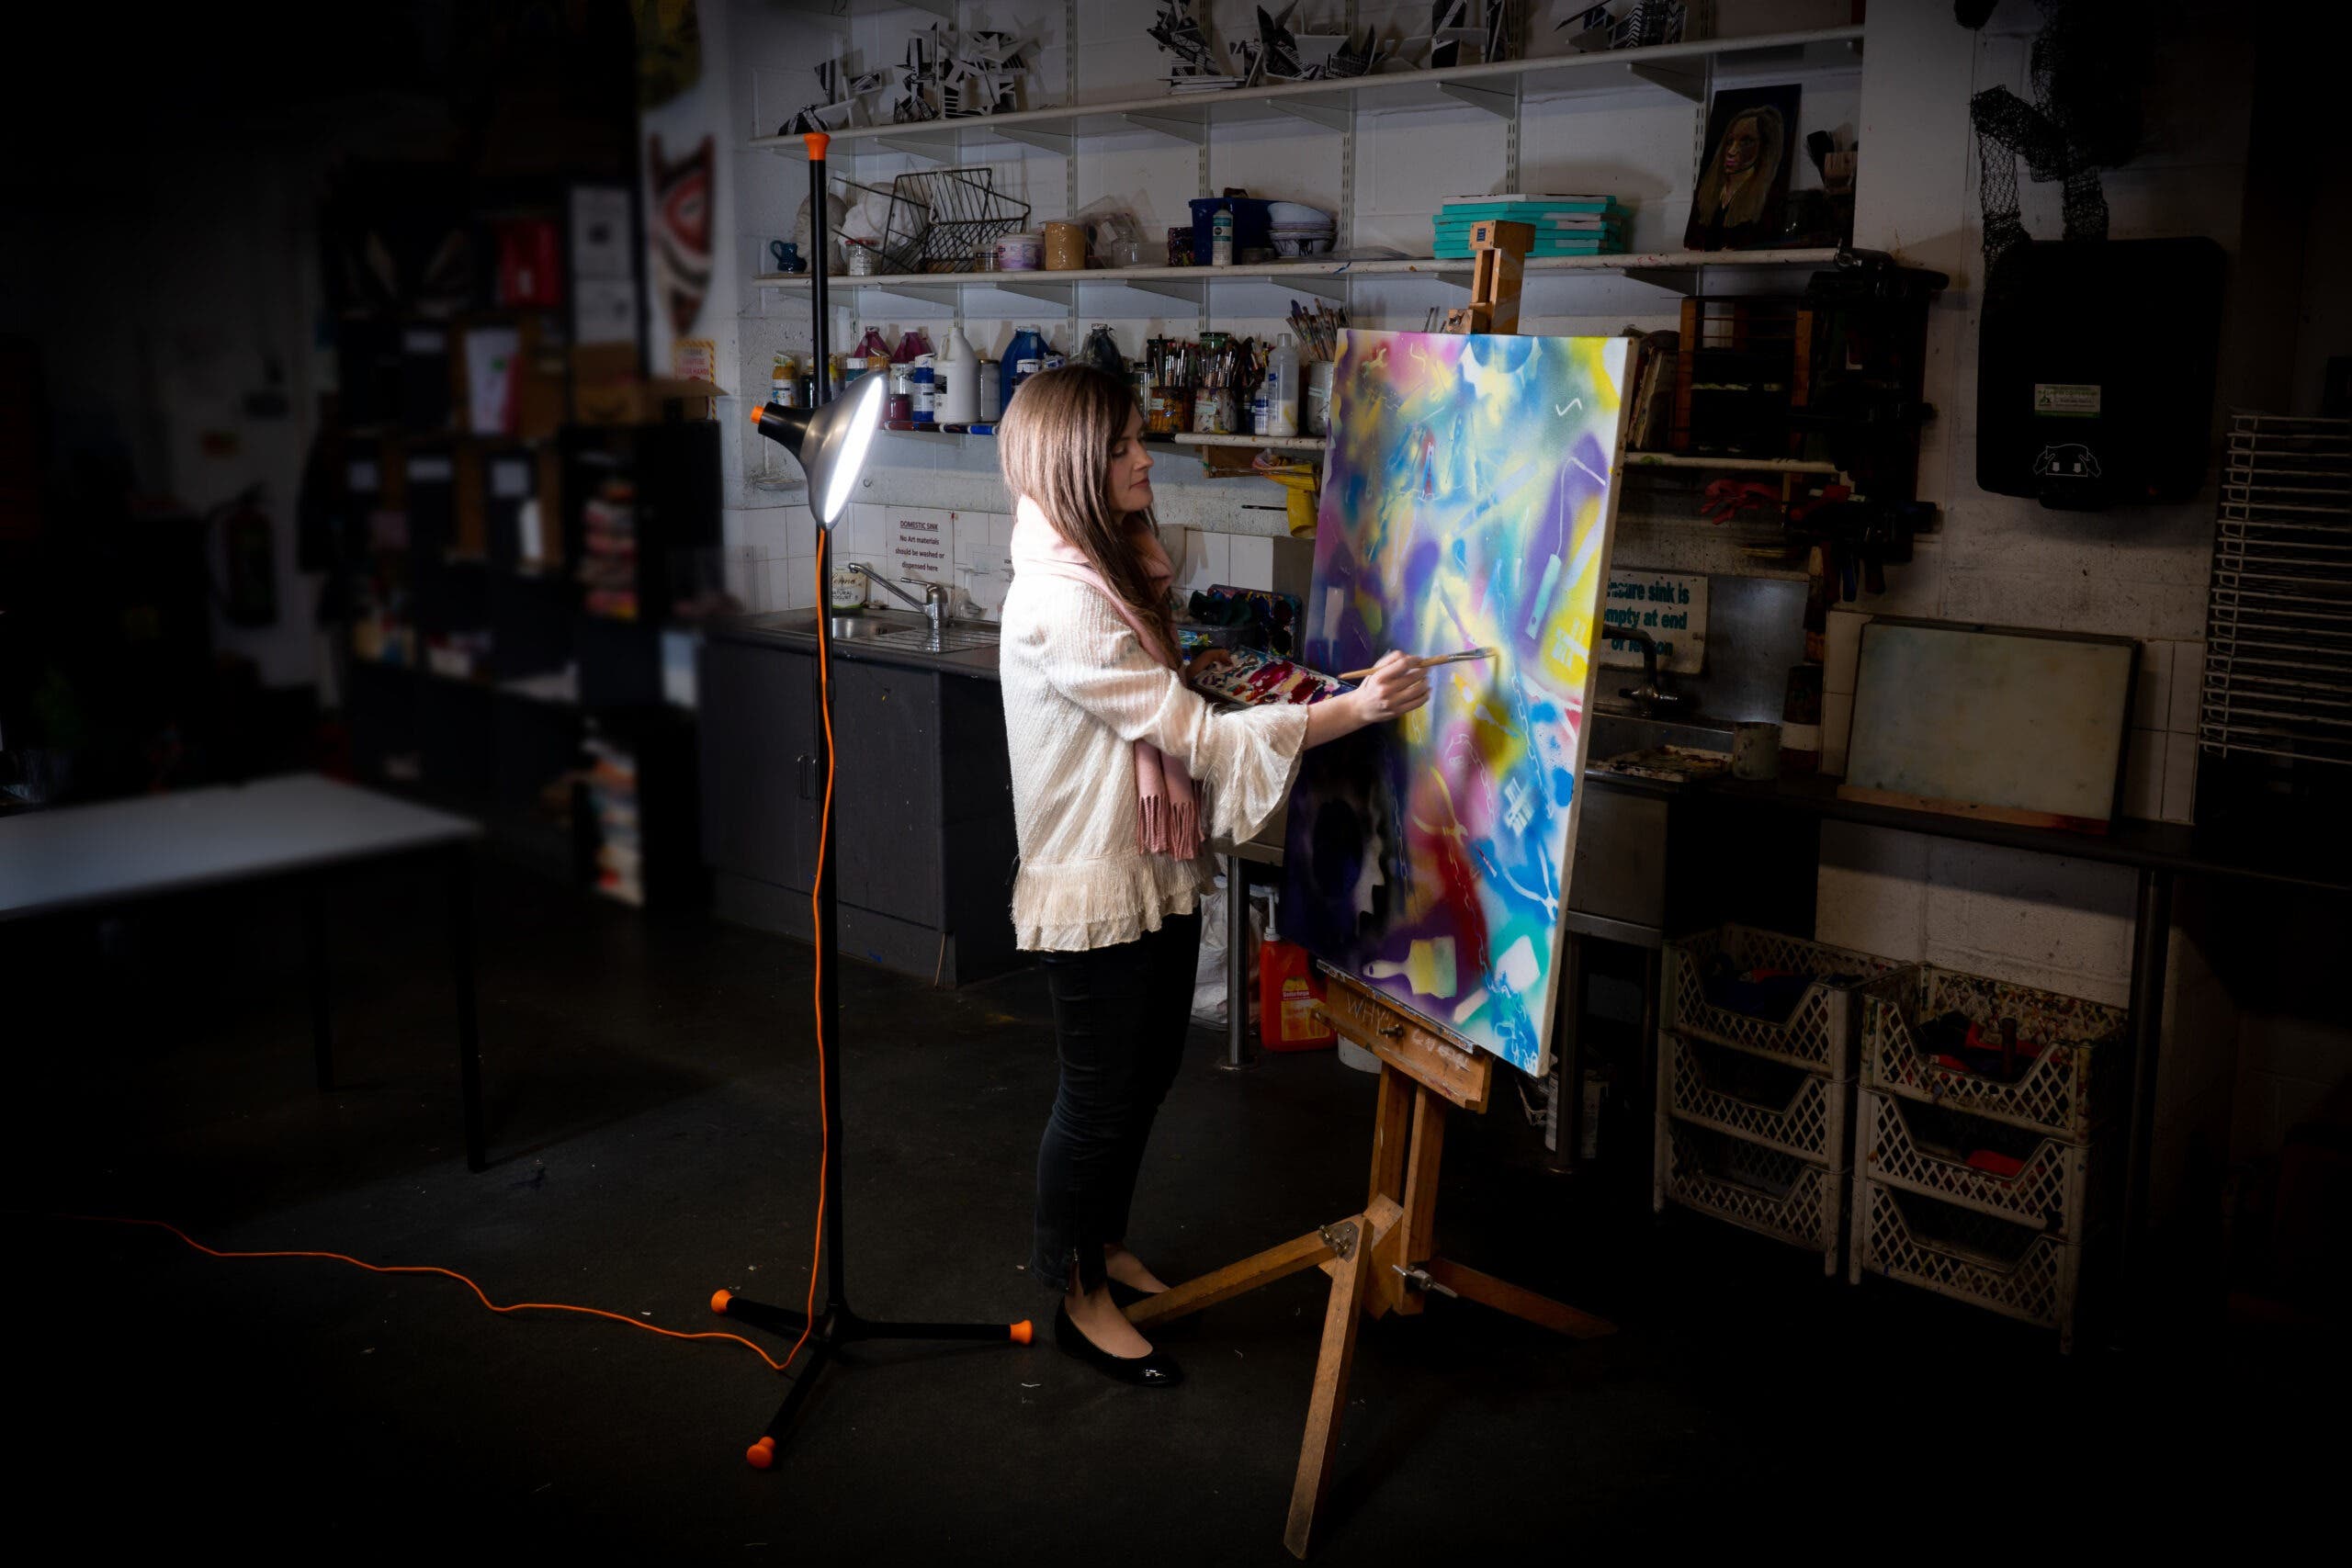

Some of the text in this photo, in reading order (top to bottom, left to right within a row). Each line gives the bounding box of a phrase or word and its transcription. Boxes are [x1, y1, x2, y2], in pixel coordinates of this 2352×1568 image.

[900, 520, 926, 530] DOMESTIC
[902, 561, 925, 570] dispensed
[1648, 581, 1675, 604] sink
[1679, 581, 1690, 604] is
[1605, 607, 1688, 630] mpty at end
